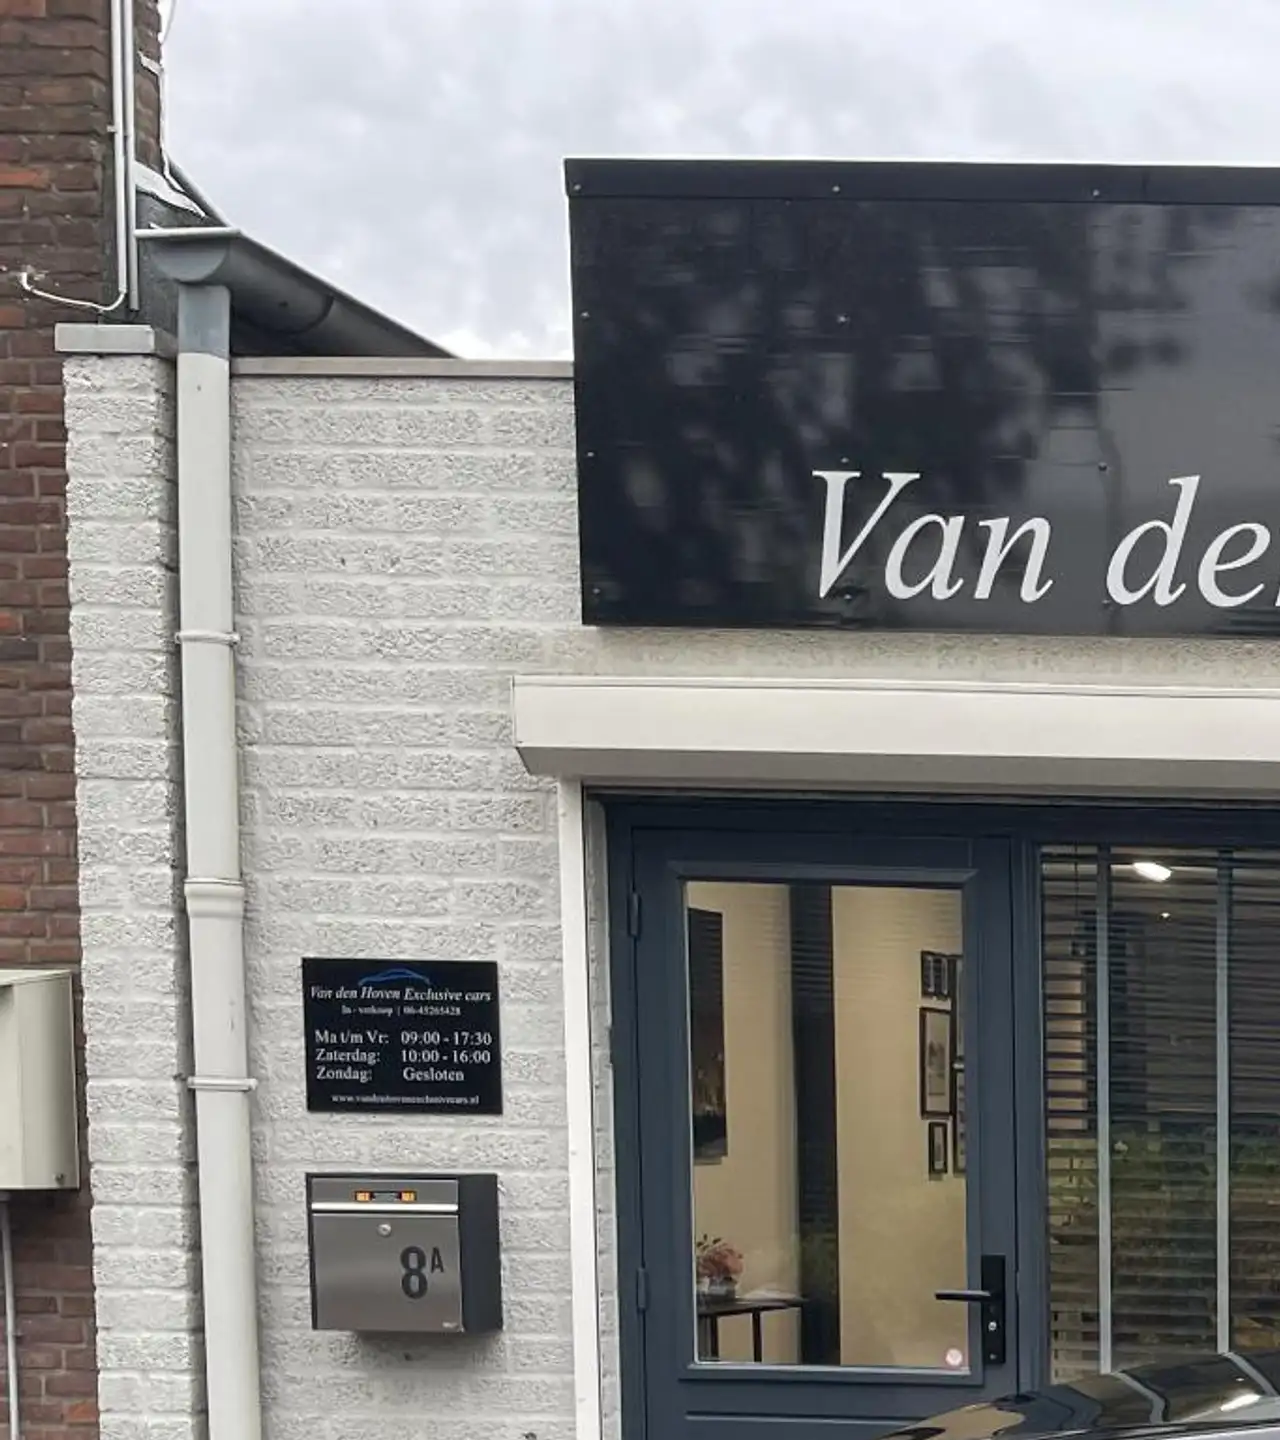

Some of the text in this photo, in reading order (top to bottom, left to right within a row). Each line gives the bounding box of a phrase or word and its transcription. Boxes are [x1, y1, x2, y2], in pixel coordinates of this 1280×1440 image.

[812, 470, 1053, 603] Van
[310, 986, 491, 1002] Van den Hoven Exclusive cars
[315, 1029, 338, 1044] Ma
[366, 1030, 390, 1045] Vr:
[400, 1031, 440, 1045] 09:00
[453, 1031, 492, 1046] 17:30
[315, 1048, 380, 1065] Zaterdag:
[400, 1049, 440, 1063] 10:00
[452, 1050, 491, 1064] 16:00
[316, 1066, 465, 1083] Zondag: Gesloten
